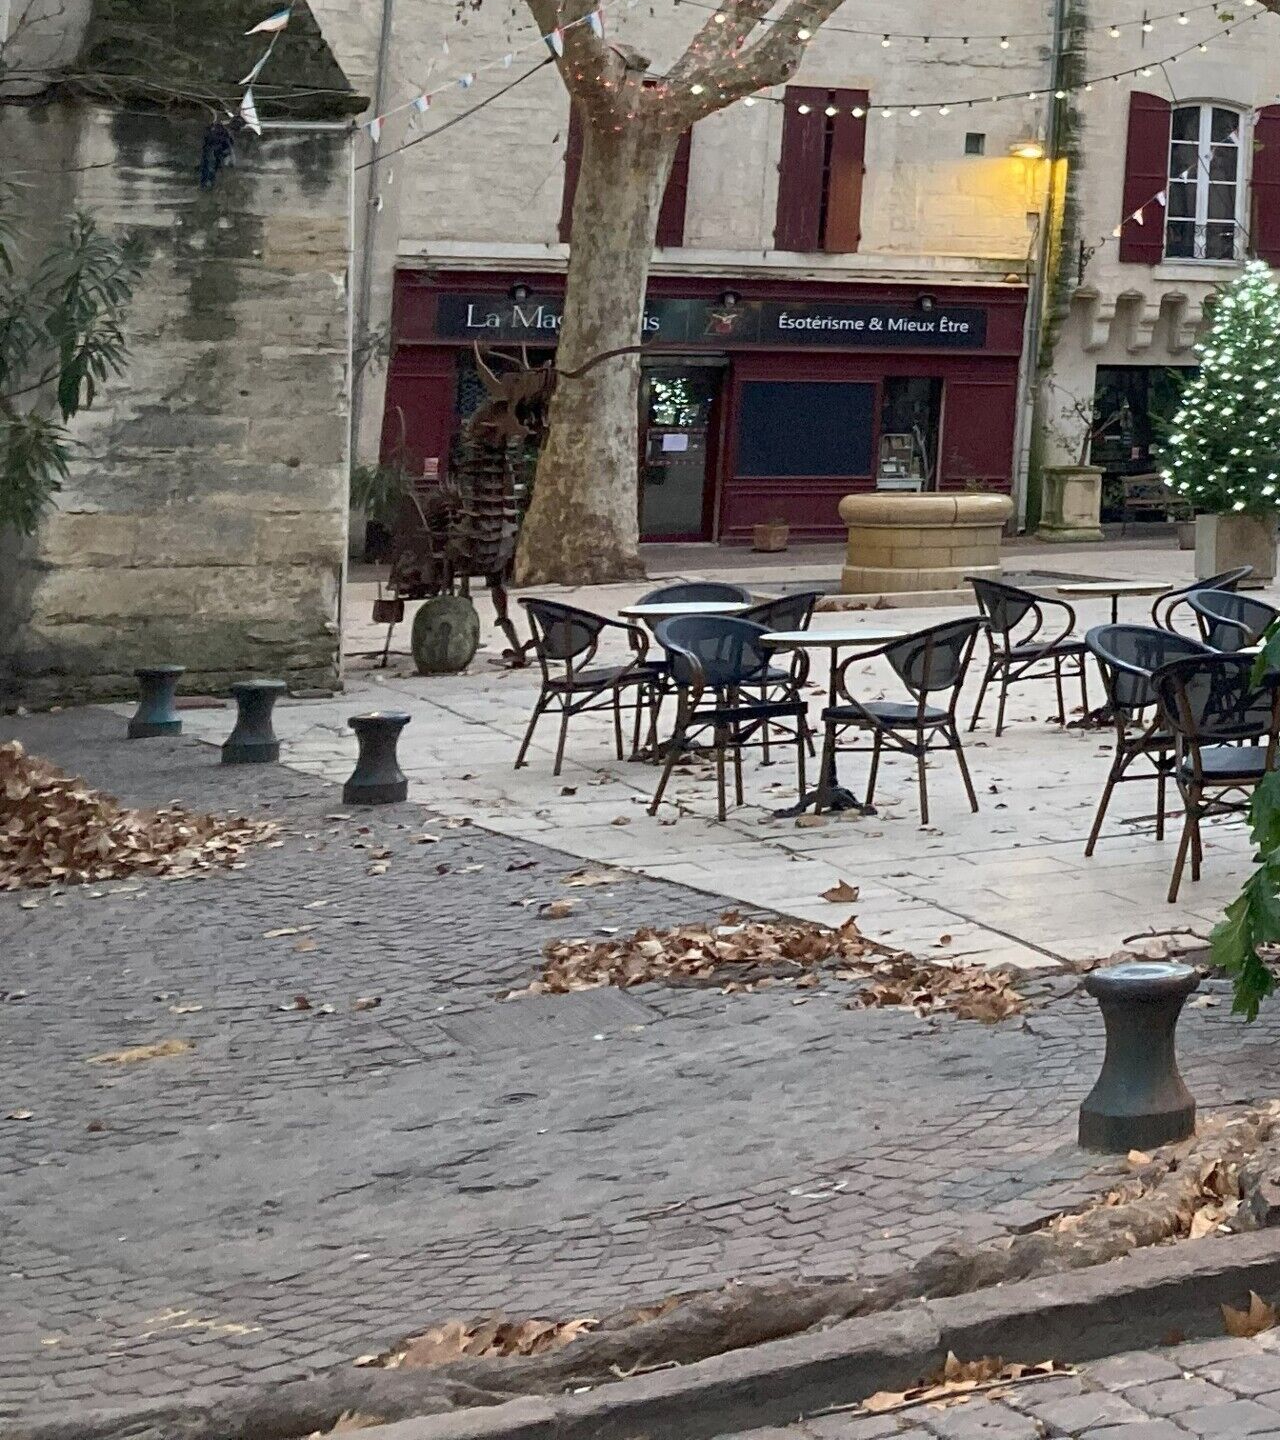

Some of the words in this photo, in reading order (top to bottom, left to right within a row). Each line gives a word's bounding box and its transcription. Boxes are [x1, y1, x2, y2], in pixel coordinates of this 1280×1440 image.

[466, 303, 500, 328] La
[778, 312, 865, 330] Ésotérisme
[868, 317, 884, 331] &
[888, 318, 935, 332] Mieux
[939, 316, 969, 333] Être
